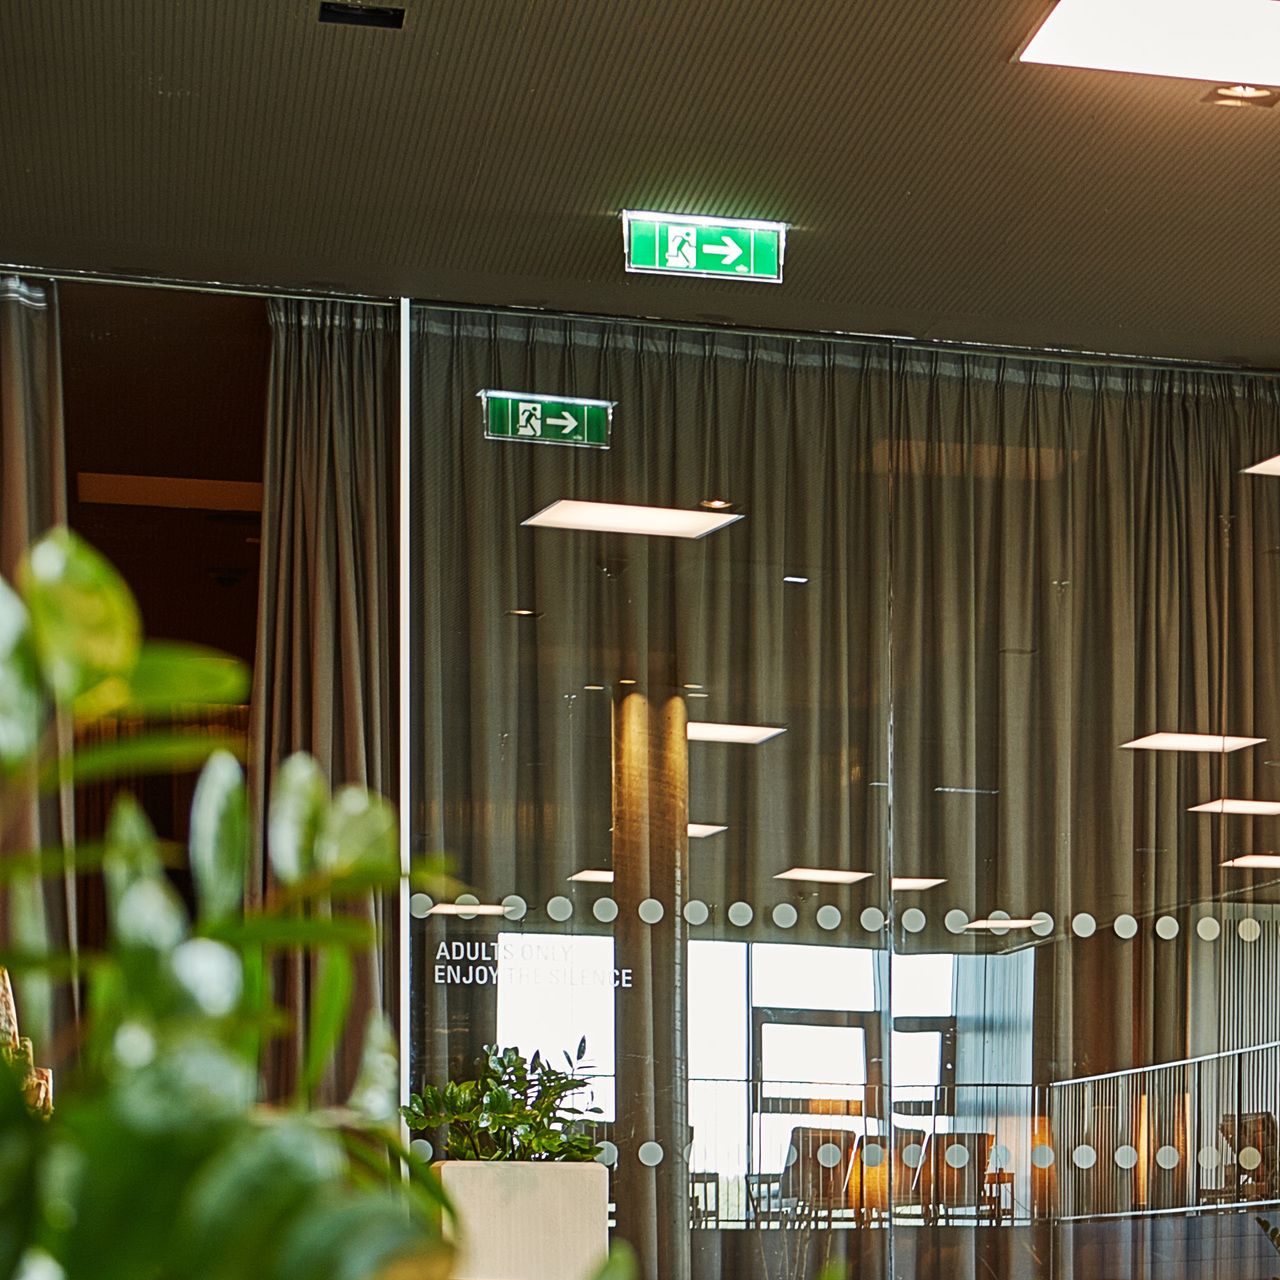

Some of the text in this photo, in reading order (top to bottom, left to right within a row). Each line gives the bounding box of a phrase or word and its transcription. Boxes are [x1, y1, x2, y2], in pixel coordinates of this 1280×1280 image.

[436, 942, 573, 962] ADULTS ONLY
[434, 965, 633, 987] ENJOY THE SILENCE
